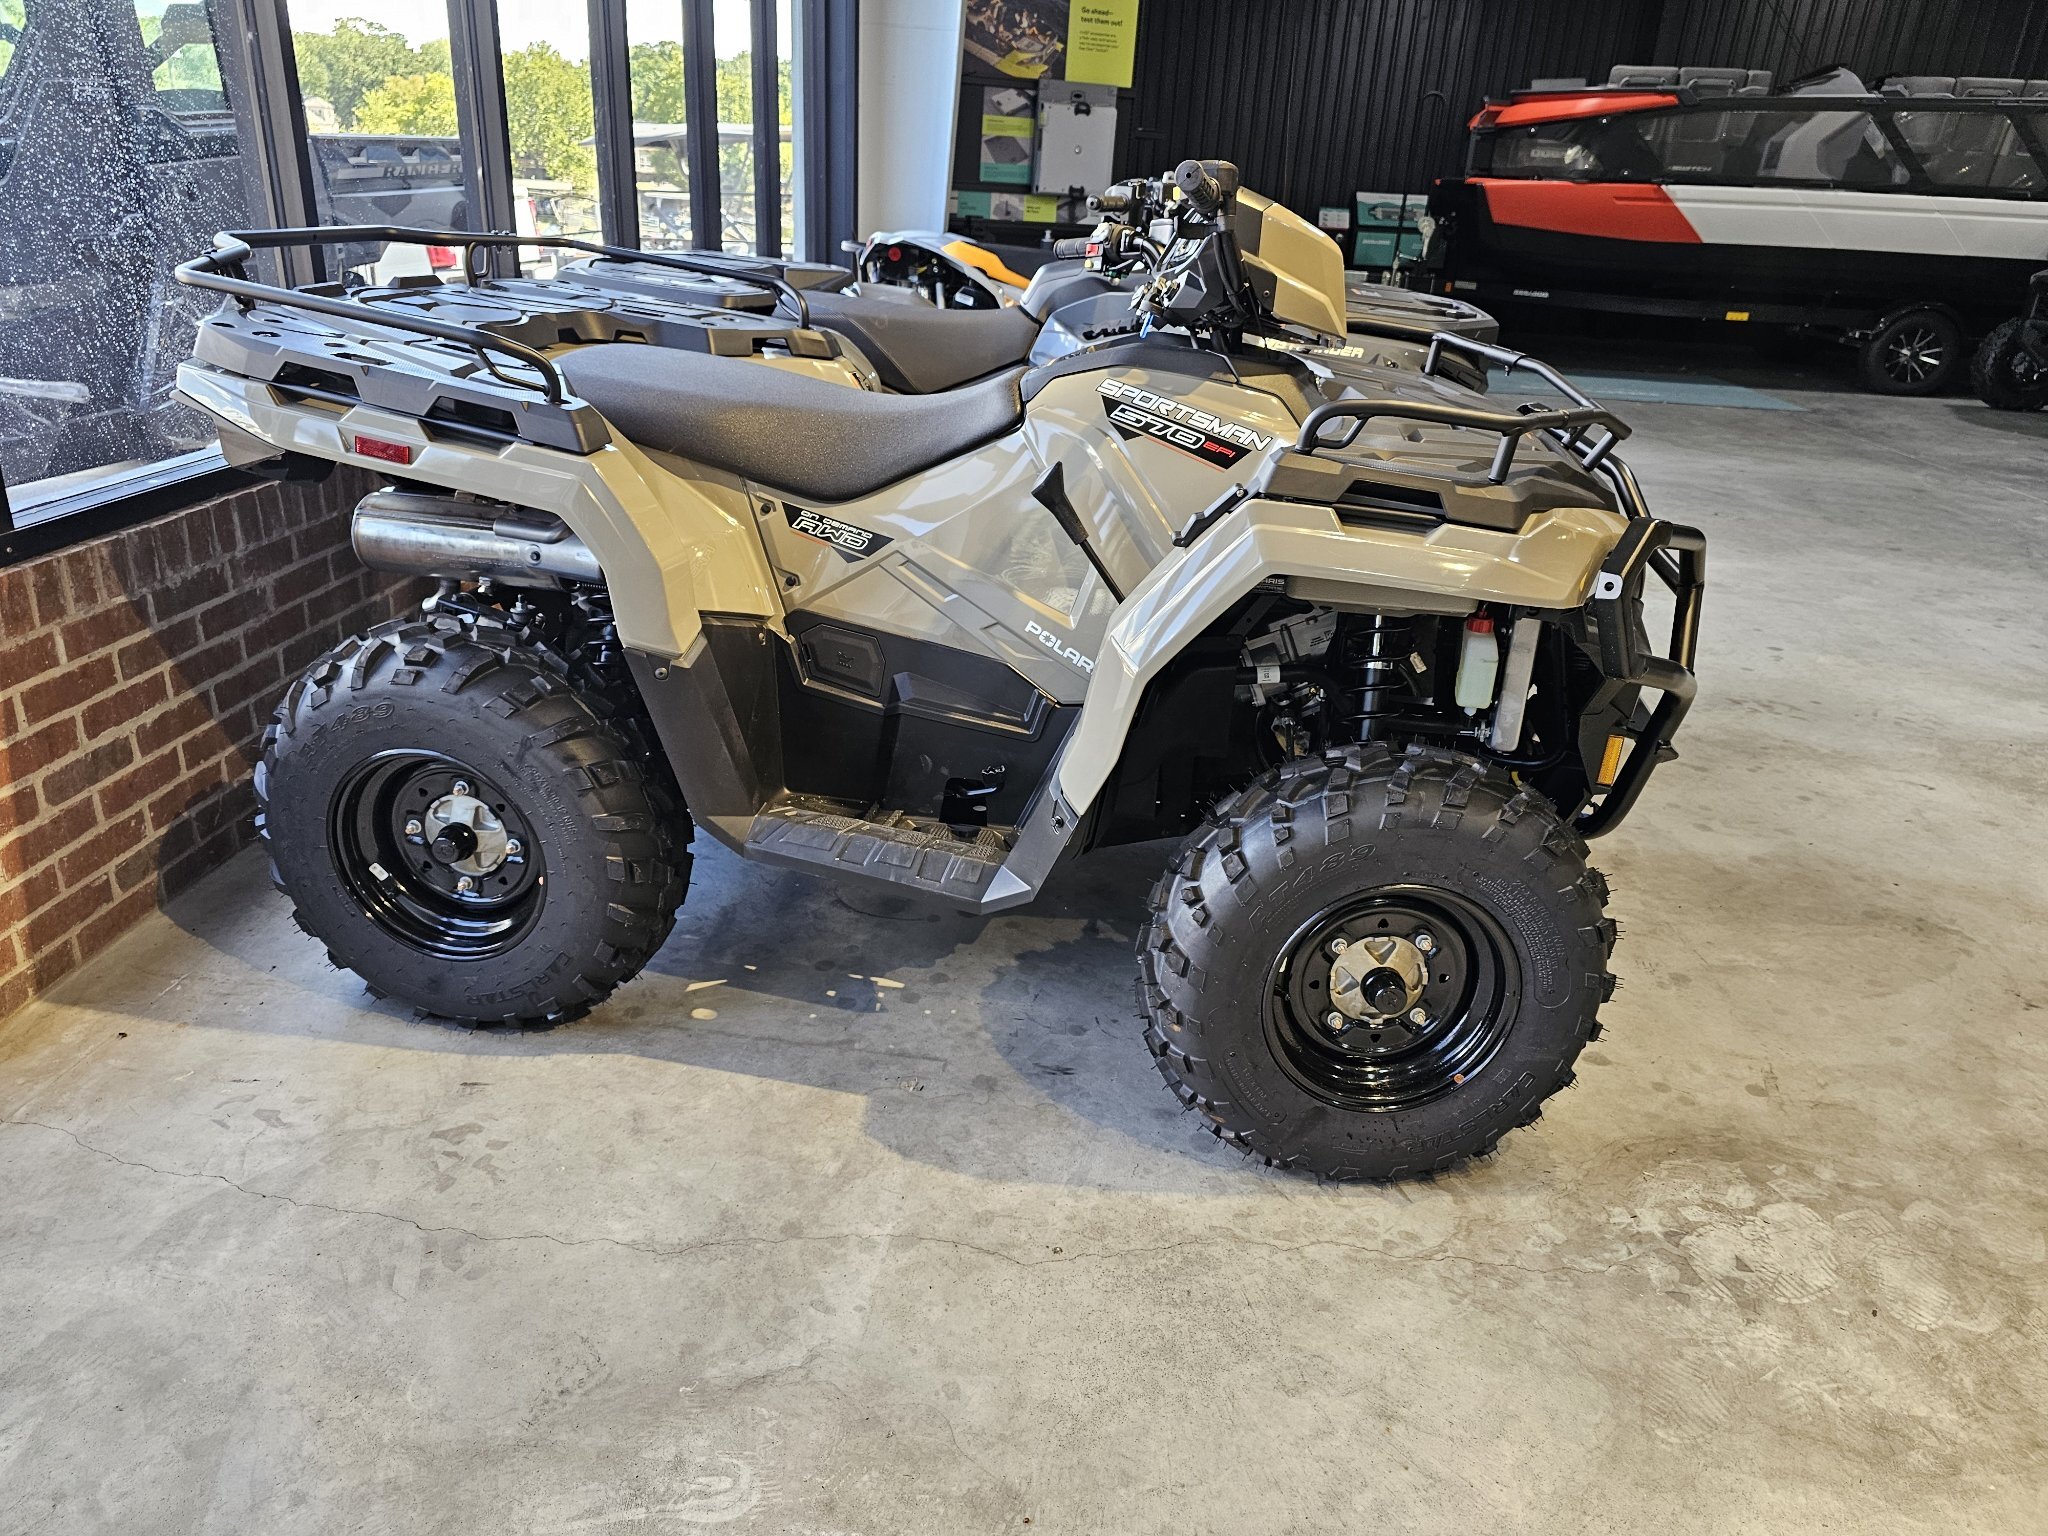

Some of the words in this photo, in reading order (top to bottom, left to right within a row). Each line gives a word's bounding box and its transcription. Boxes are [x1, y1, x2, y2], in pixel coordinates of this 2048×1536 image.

[1081, 6, 1090, 14] Go
[1096, 377, 1273, 451] SPORTSMAN
[1110, 404, 1206, 449] 570
[792, 516, 869, 549] AWD
[1024, 620, 1095, 675] POLAR
